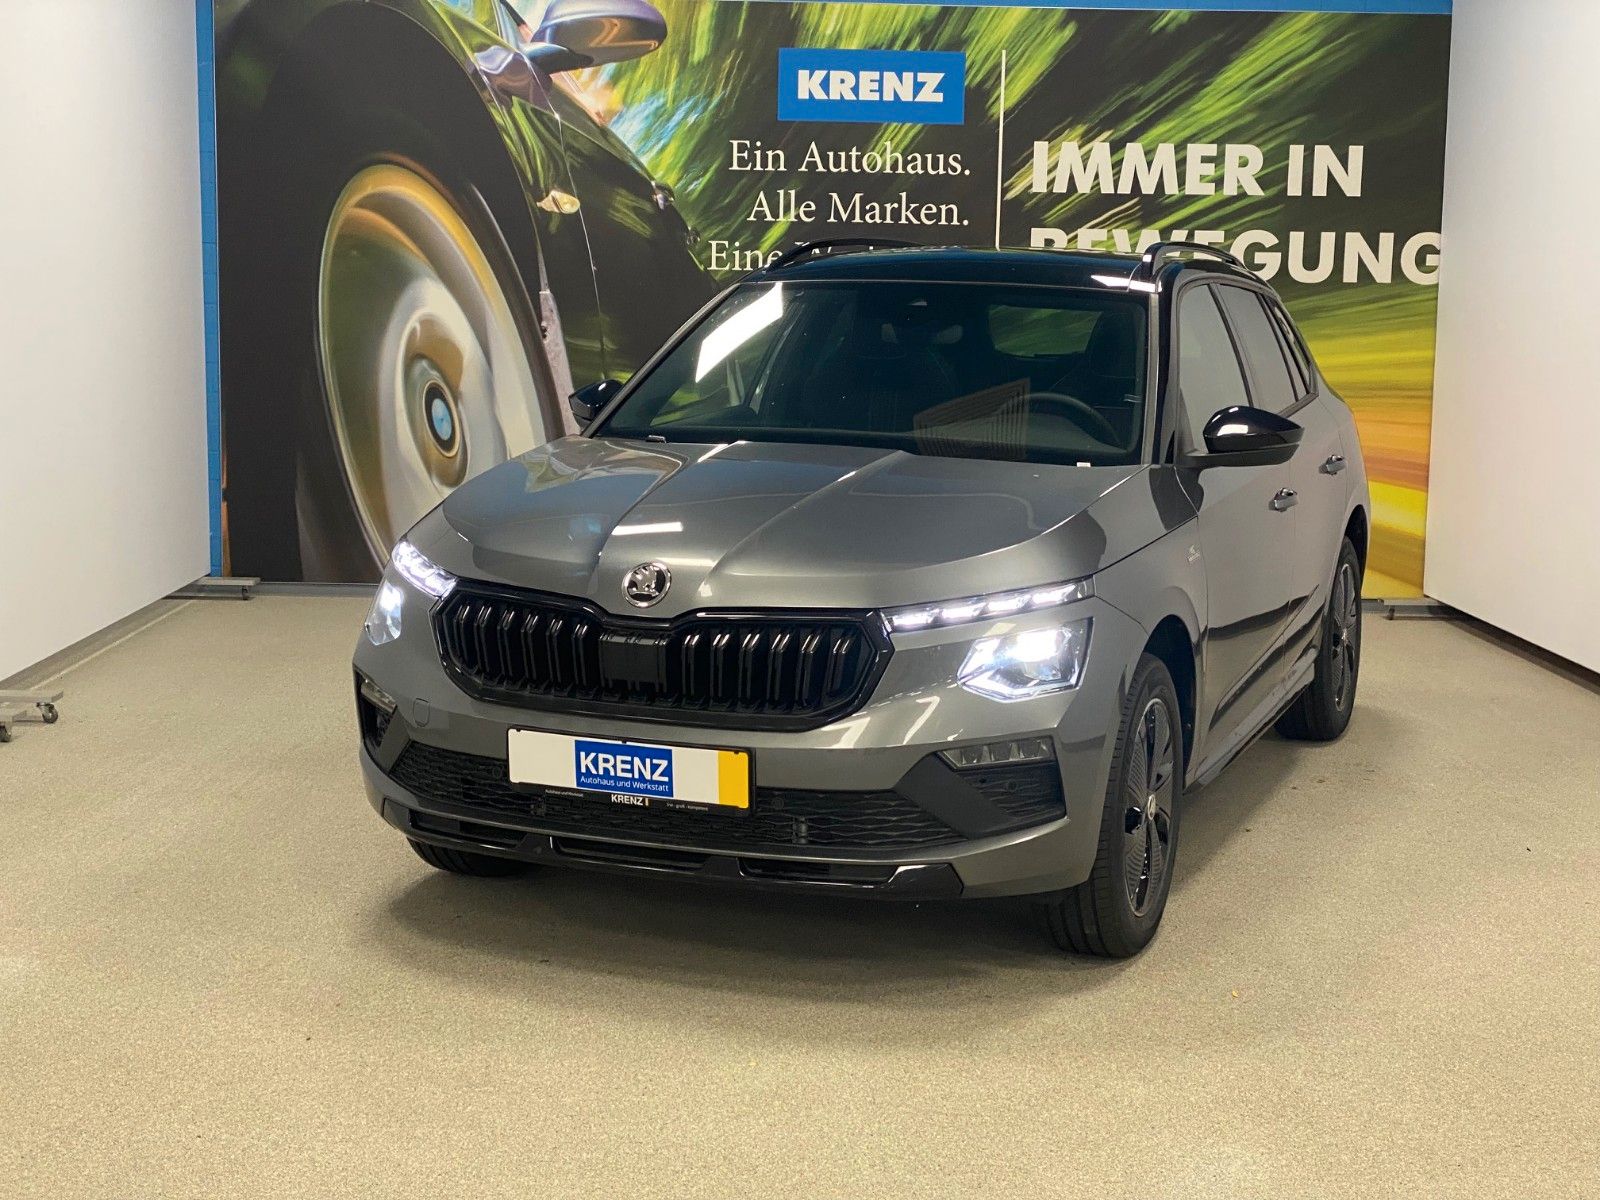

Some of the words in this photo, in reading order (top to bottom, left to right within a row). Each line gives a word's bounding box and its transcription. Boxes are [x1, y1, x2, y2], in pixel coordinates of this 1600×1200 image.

[797, 69, 945, 103] KRENZ
[728, 139, 787, 171] Ein
[798, 141, 971, 176] Autohaus.
[1031, 140, 1265, 197] IMMER
[1287, 144, 1364, 197] IN
[746, 189, 817, 223] Alle
[826, 192, 970, 226] Marken.
[579, 751, 669, 782] KRENZ
[580, 775, 615, 786] Autohaus
[616, 780, 631, 788] und
[632, 781, 669, 792] Werkstatt
[611, 793, 643, 805] KRENZ
